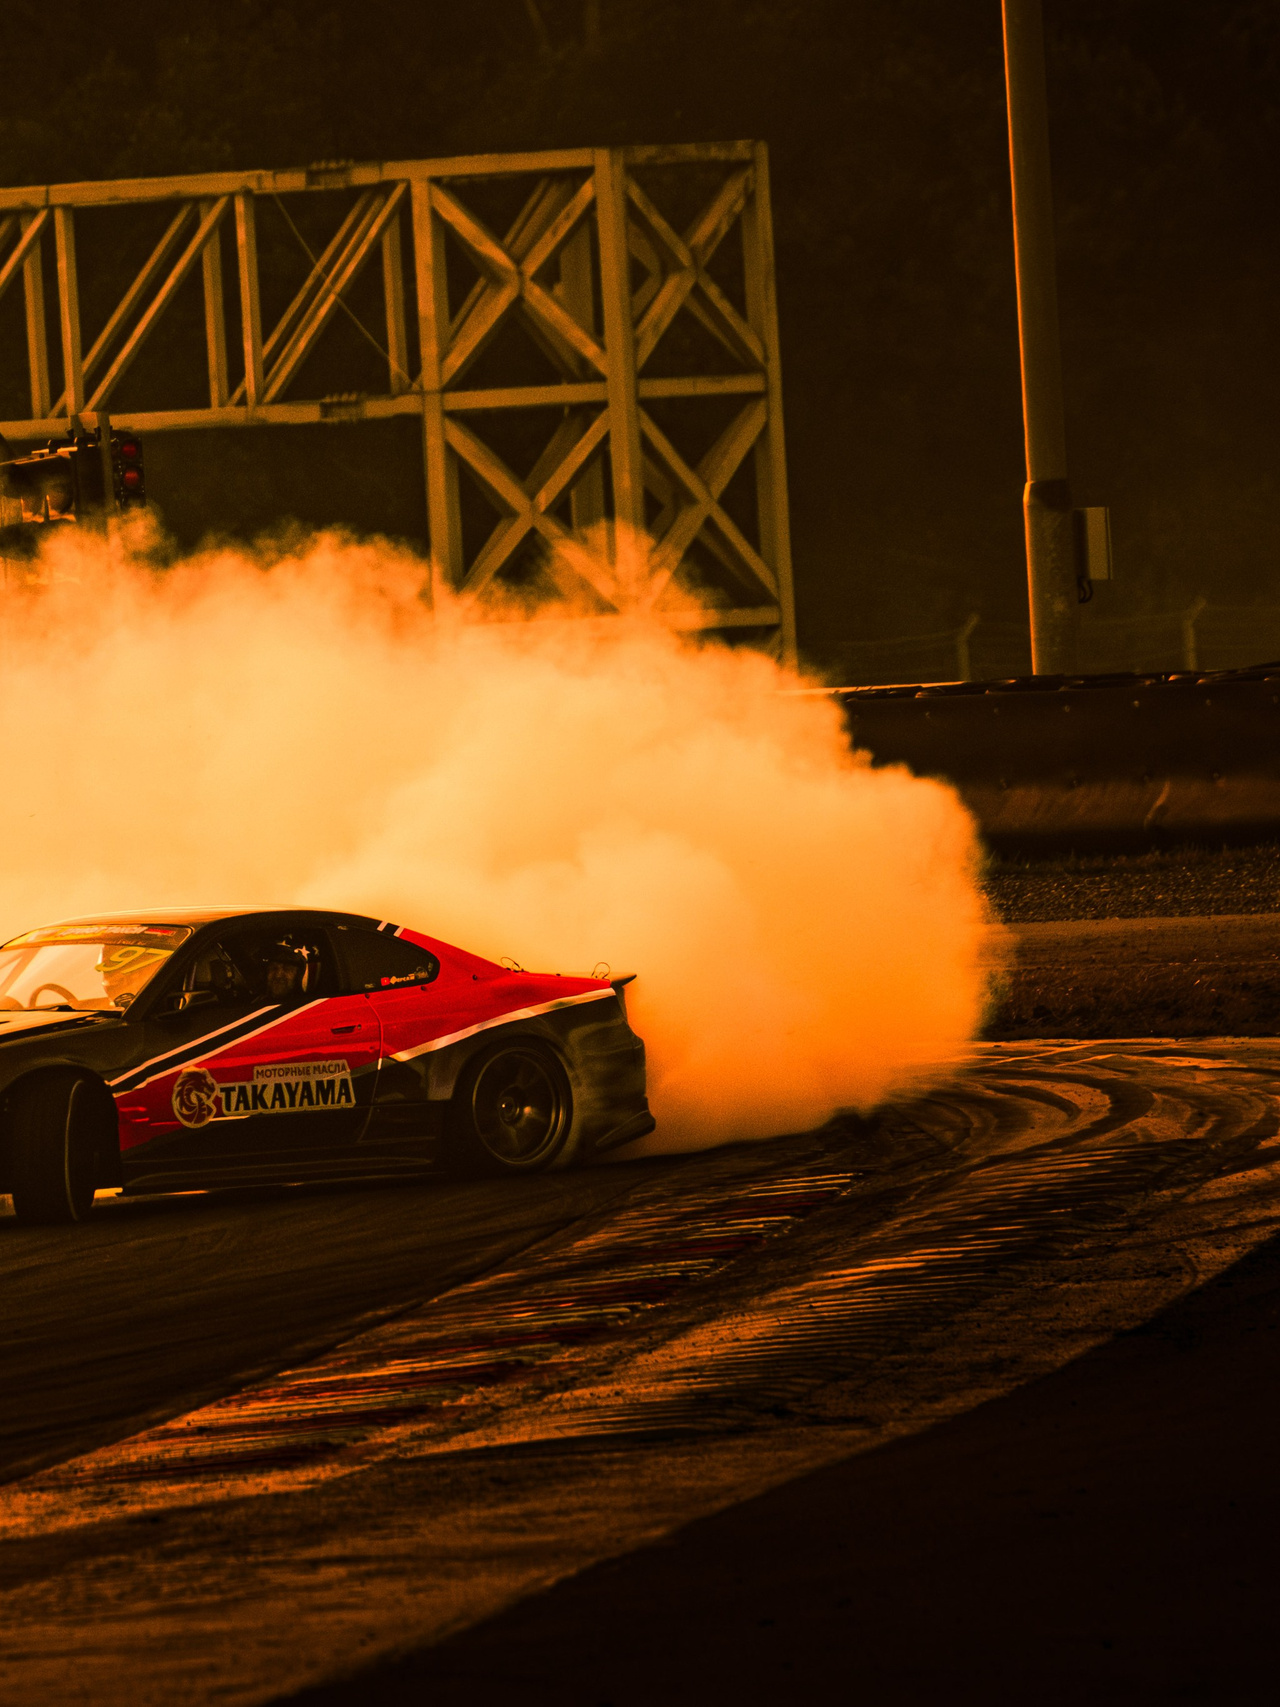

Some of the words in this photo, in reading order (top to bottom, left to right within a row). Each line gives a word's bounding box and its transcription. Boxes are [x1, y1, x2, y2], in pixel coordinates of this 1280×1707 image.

[95, 946, 175, 974] 97
[256, 1065, 311, 1079] МОТОРНЫЕ
[313, 1062, 347, 1075] МАСЛА
[220, 1078, 353, 1112] TAKAYAMA
